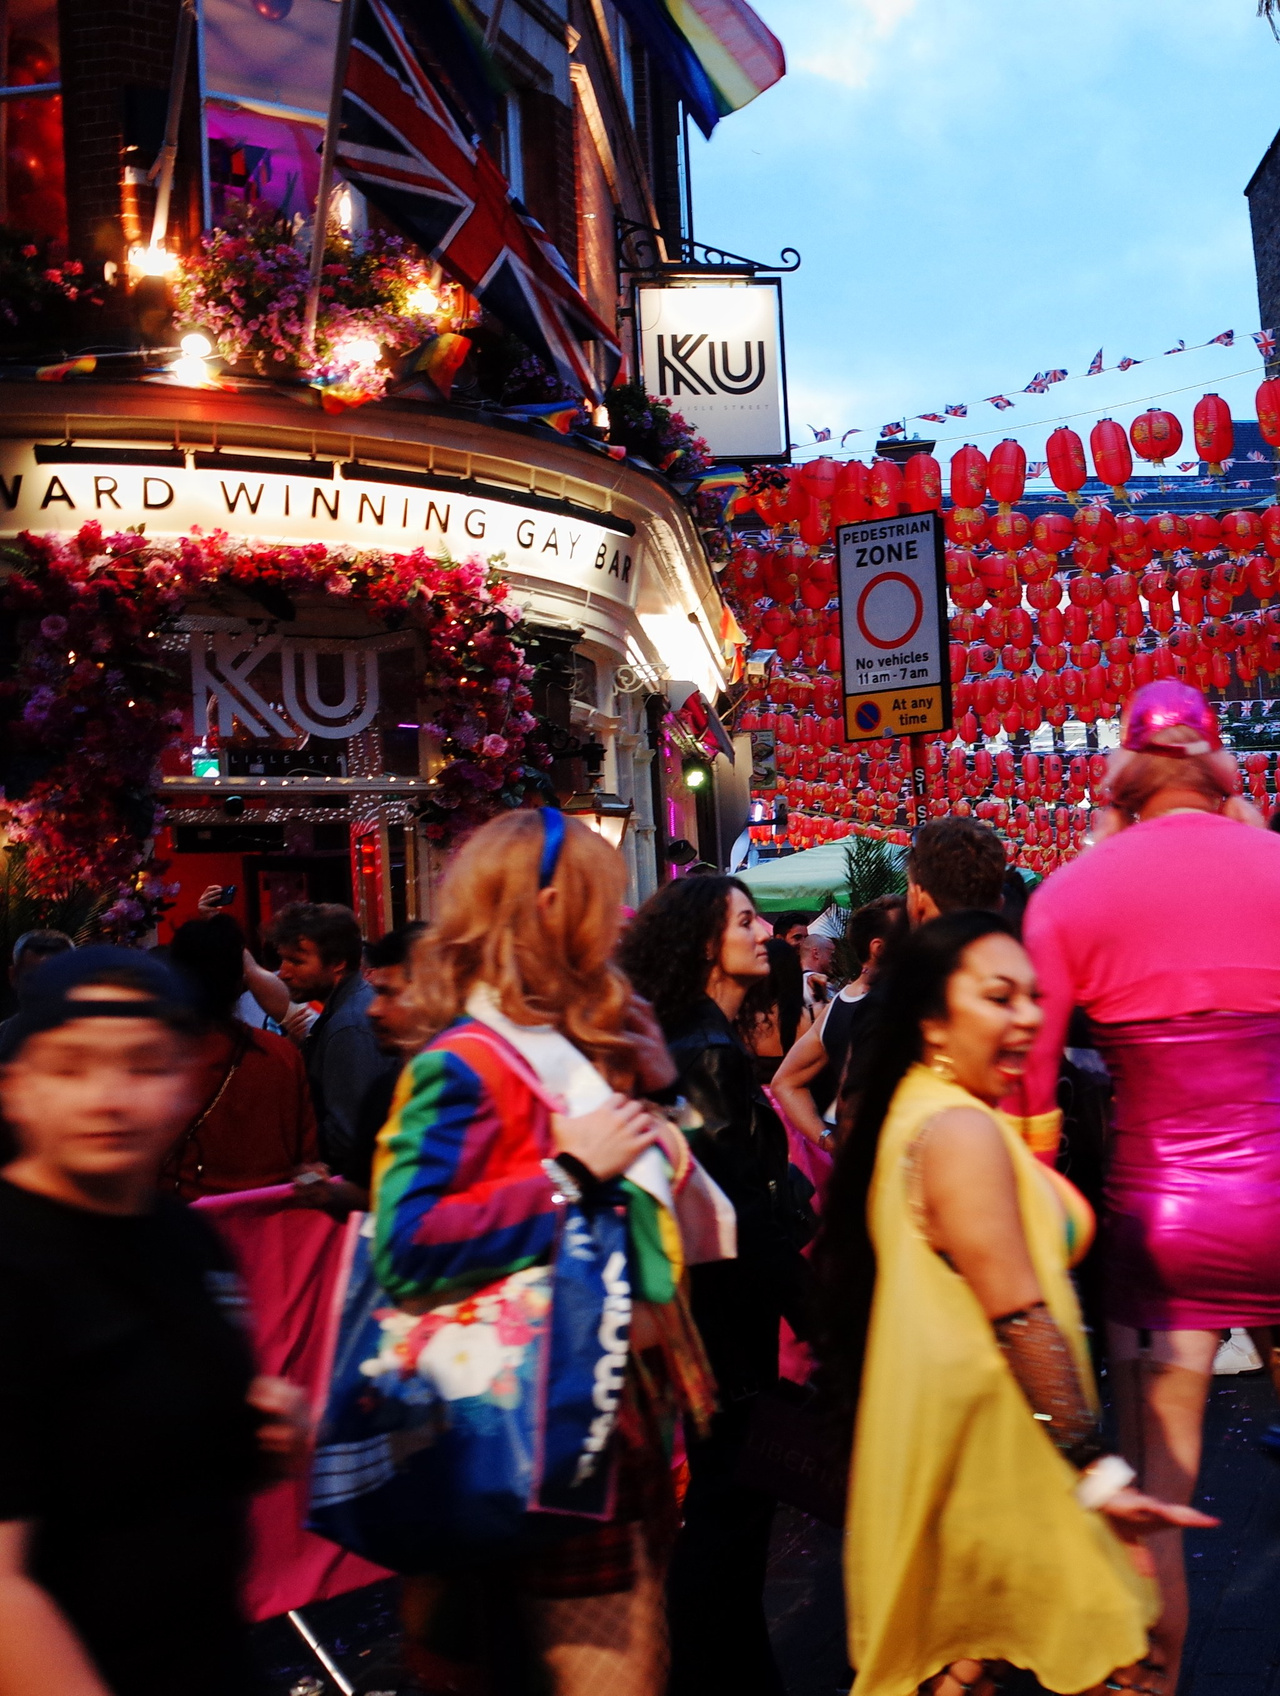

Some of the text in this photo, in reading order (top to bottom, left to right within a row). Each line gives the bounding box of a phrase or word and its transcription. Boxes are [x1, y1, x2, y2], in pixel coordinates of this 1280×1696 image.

[657, 334, 765, 396] KU
[219, 480, 486, 540] WINNING
[516, 519, 582, 560] GAY
[594, 542, 633, 584] BAR
[842, 519, 931, 546] PEDESTRIAN
[855, 539, 918, 568] ZONE
[855, 651, 929, 671] No vehicles
[191, 633, 380, 740] KU
[892, 697, 934, 711] At any
[899, 712, 928, 726] time
[231, 755, 290, 764] LISLE
[914, 768, 925, 795] S1
